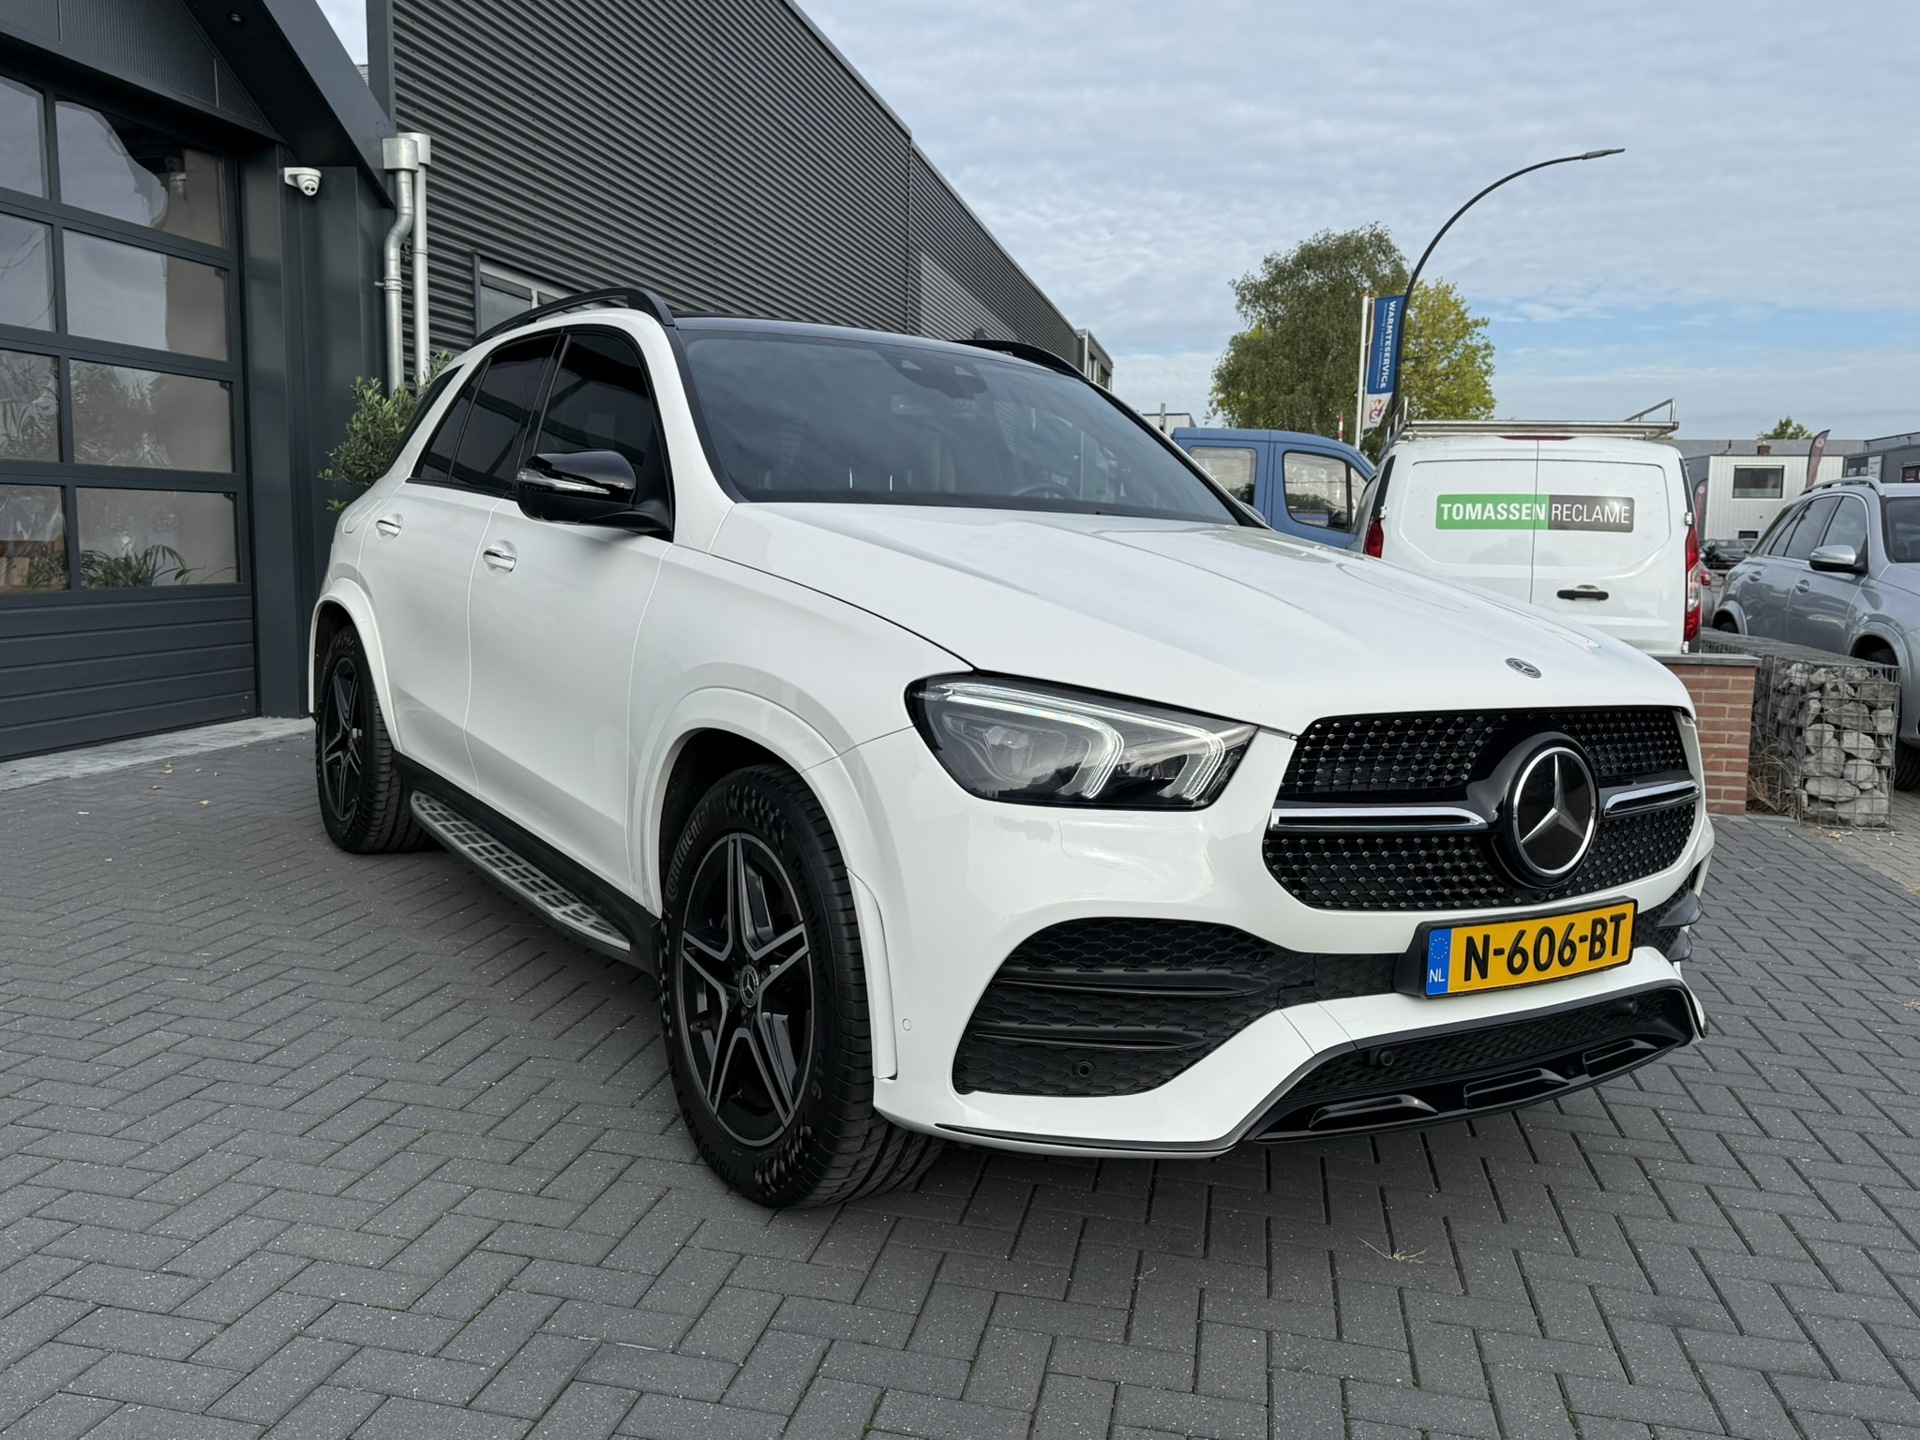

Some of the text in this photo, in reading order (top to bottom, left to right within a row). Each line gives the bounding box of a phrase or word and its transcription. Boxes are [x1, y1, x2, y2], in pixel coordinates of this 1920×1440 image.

[1380, 300, 1396, 389] WARMTESERVICE
[1441, 503, 1630, 524] TOMASSEN RECLAME
[665, 800, 710, 902] Continental
[1429, 968, 1445, 983] NL
[1464, 912, 1627, 982] N-606-BT
